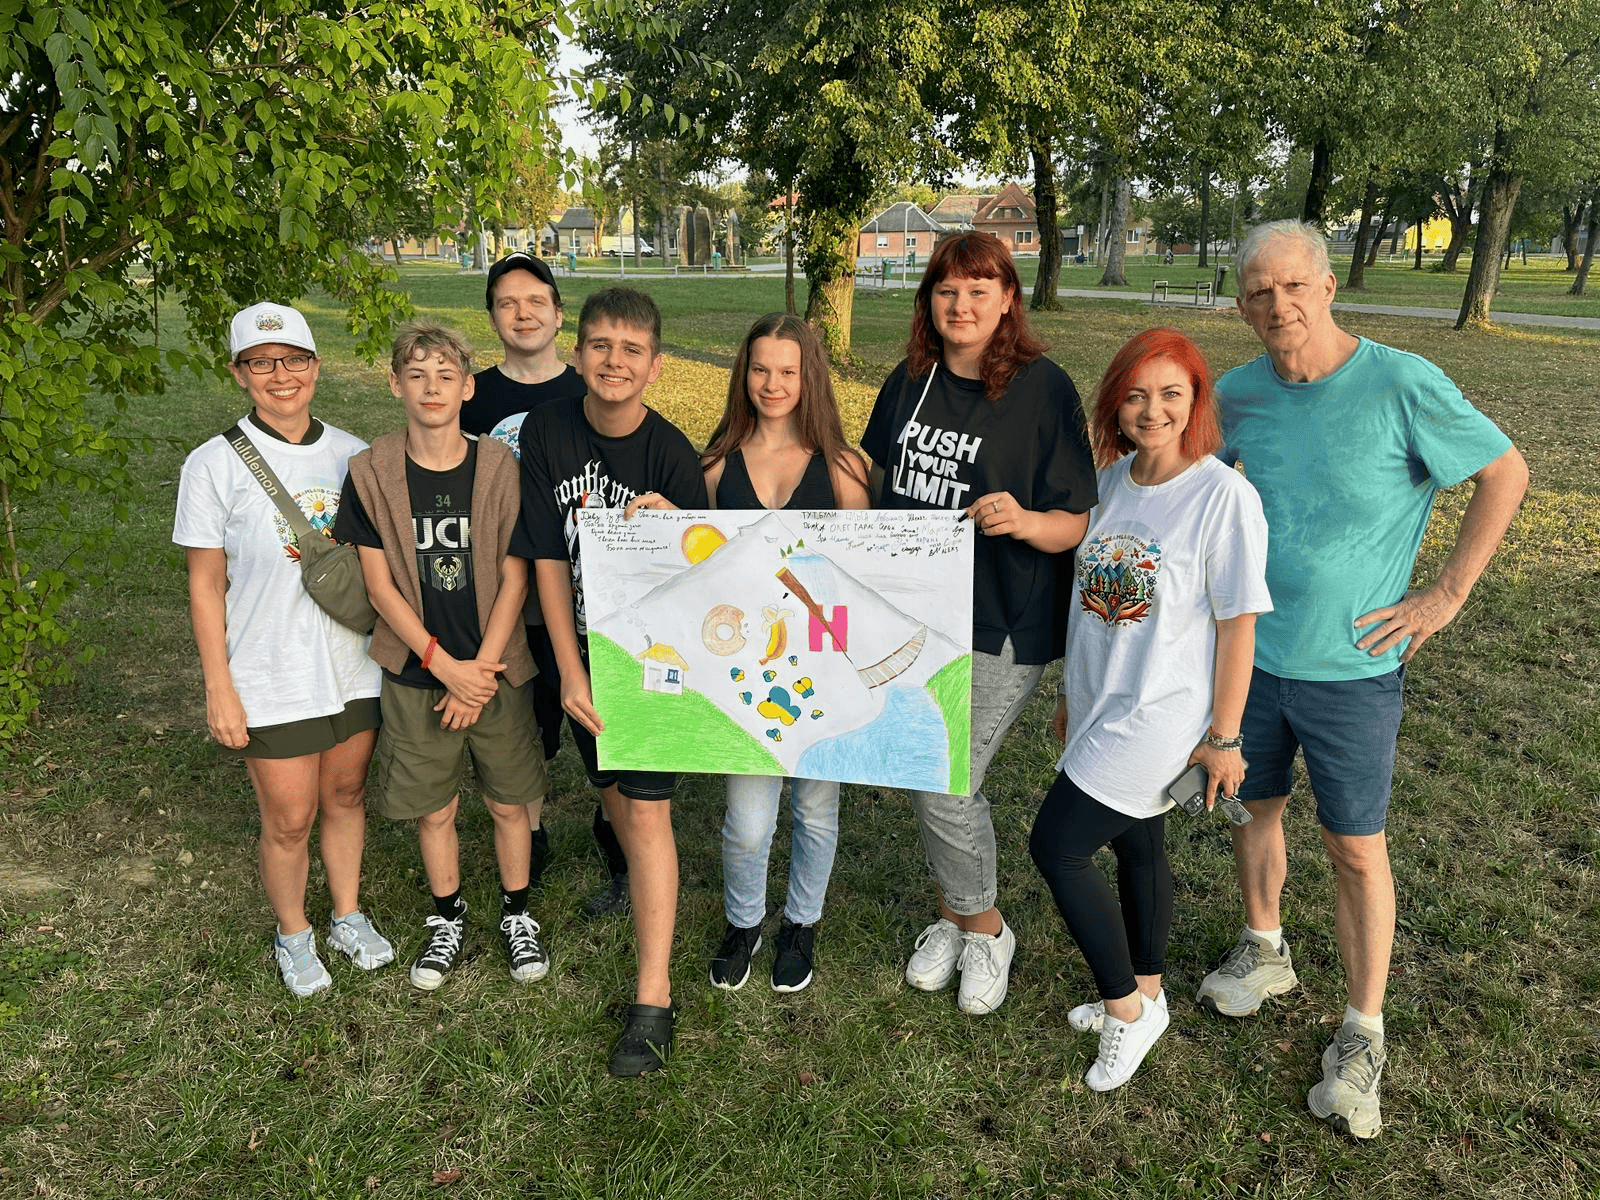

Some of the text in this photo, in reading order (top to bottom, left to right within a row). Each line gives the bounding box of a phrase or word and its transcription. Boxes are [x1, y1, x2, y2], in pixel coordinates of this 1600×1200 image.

[897, 420, 982, 464] PUSH
[231, 435, 279, 496] lululemon
[892, 465, 971, 510] LIMIT
[435, 494, 451, 507] 34
